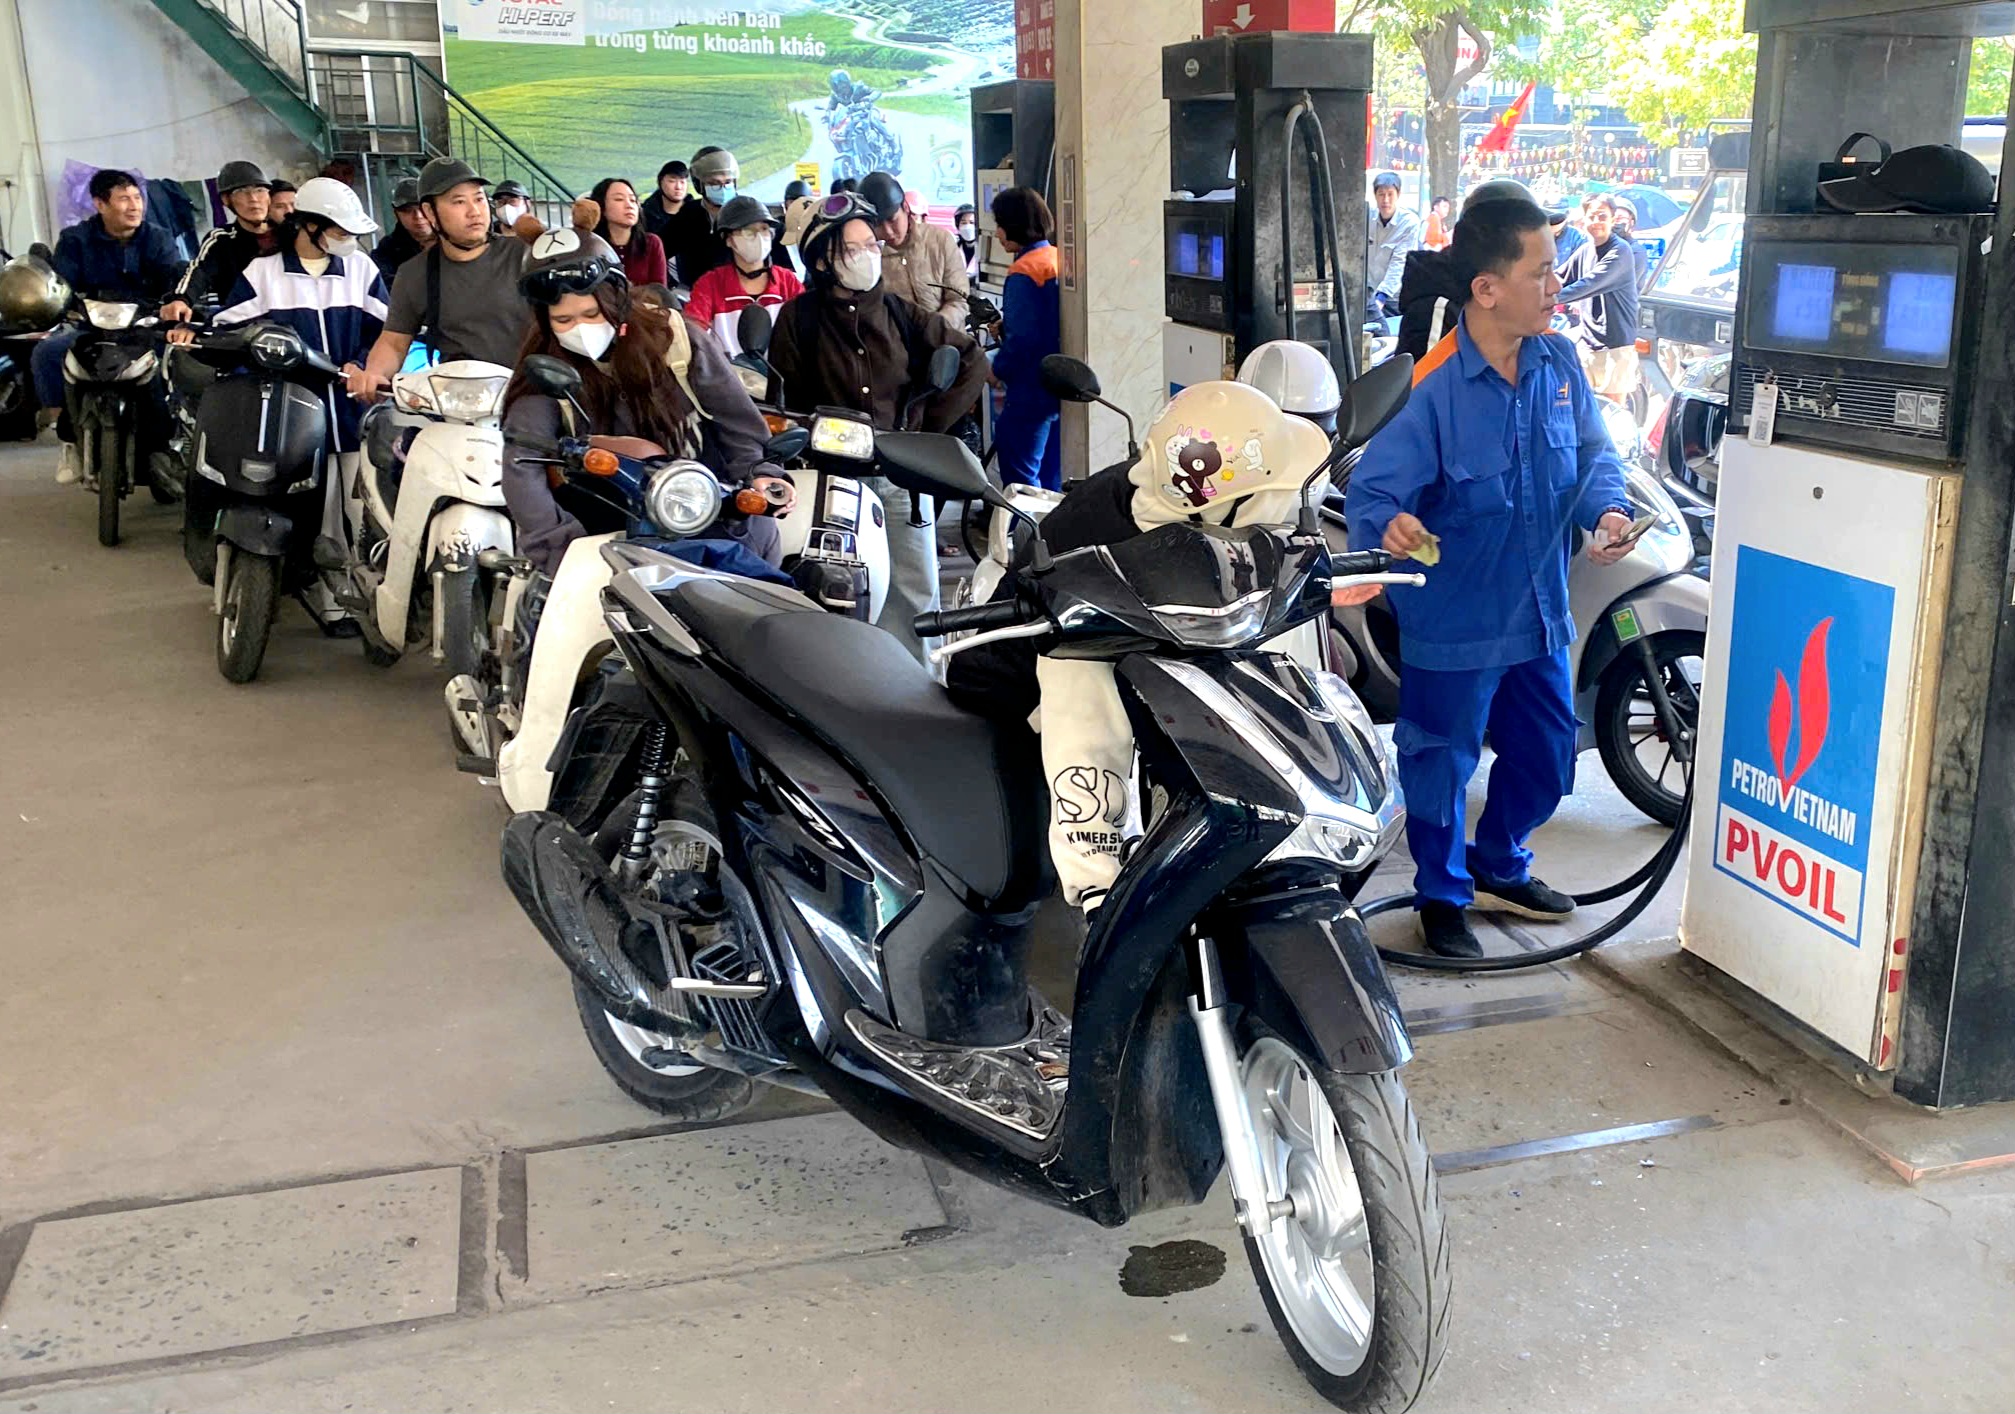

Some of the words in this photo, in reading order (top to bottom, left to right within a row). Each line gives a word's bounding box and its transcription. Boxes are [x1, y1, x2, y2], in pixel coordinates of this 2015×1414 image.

[498, 7, 575, 26] HI-PERF
[744, 11, 781, 33] bạn
[594, 31, 647, 53] trong
[652, 31, 698, 55] từng
[703, 32, 774, 55] khoảnh
[780, 33, 826, 57] khắc
[1731, 758, 1857, 846] PETROVIETNAM
[1726, 817, 1846, 924] PVOIL
